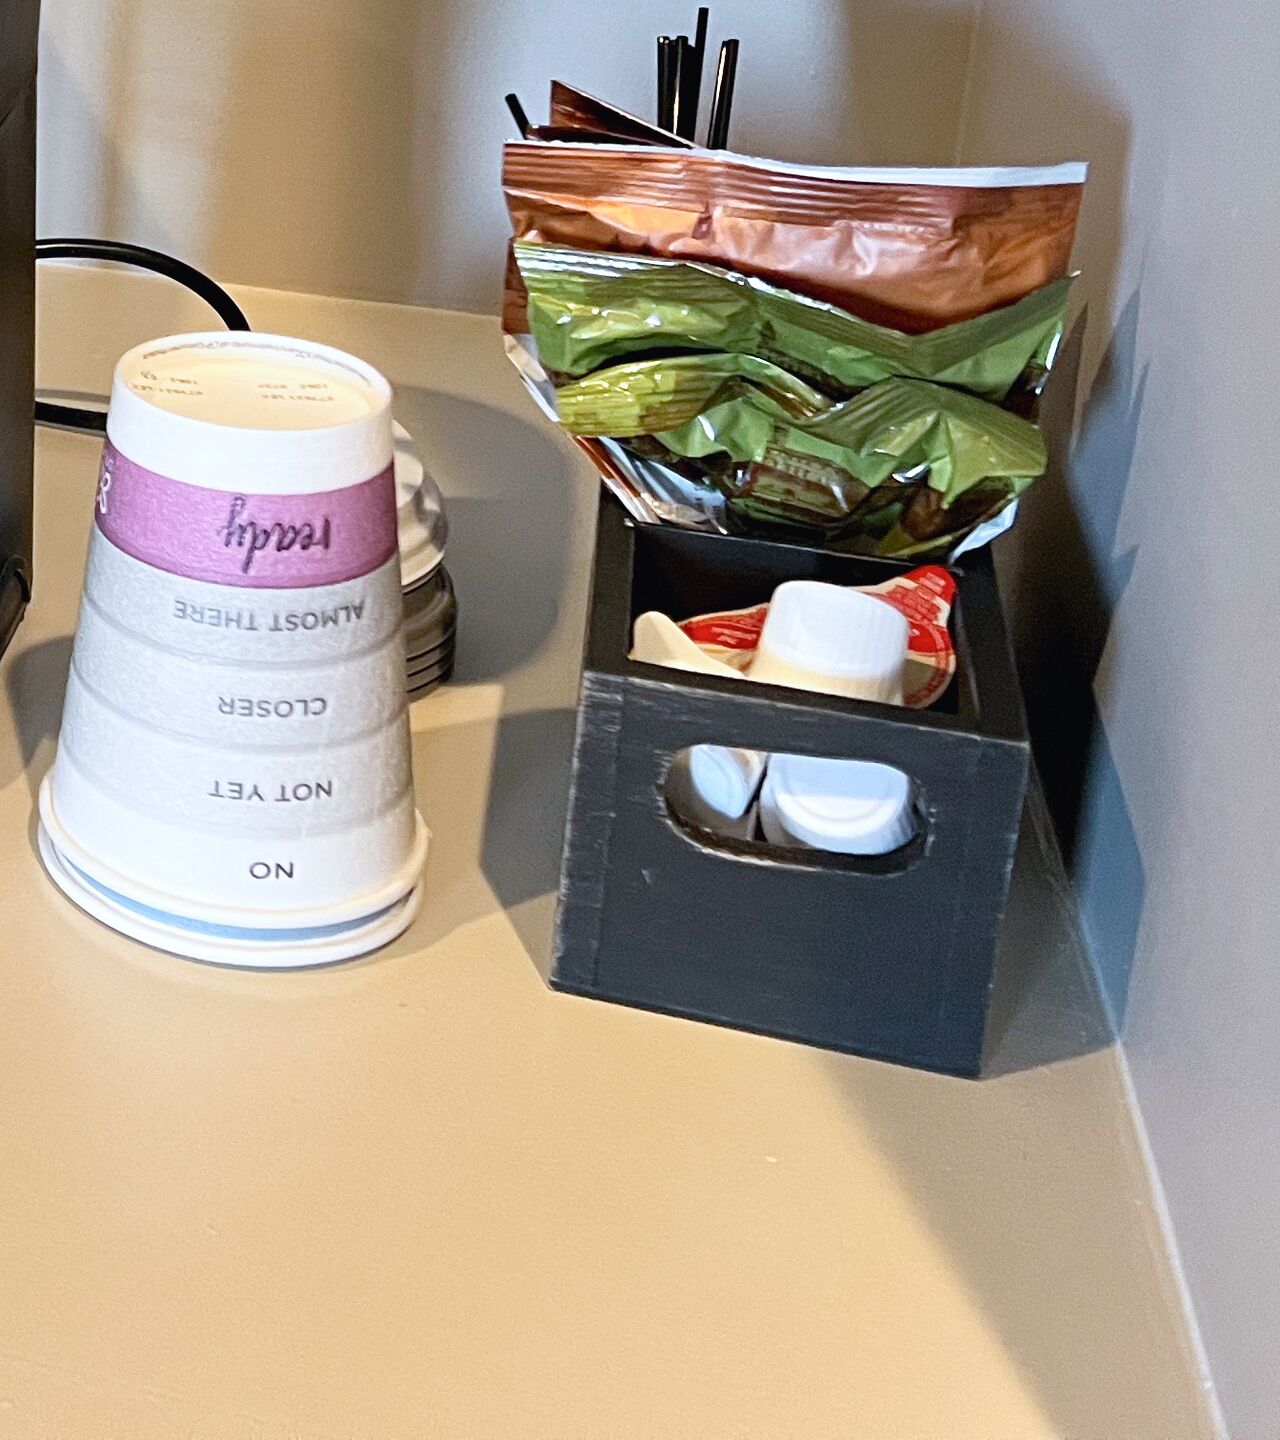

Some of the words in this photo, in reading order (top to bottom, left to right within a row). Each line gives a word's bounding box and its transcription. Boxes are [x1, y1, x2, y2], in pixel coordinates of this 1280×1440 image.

[217, 494, 332, 574] ready
[173, 599, 259, 632] THERE
[268, 599, 366, 633] ALMOST
[218, 695, 328, 718] CLOSER
[207, 779, 265, 802] YET
[275, 779, 333, 802] NOT
[249, 861, 295, 880] NO
